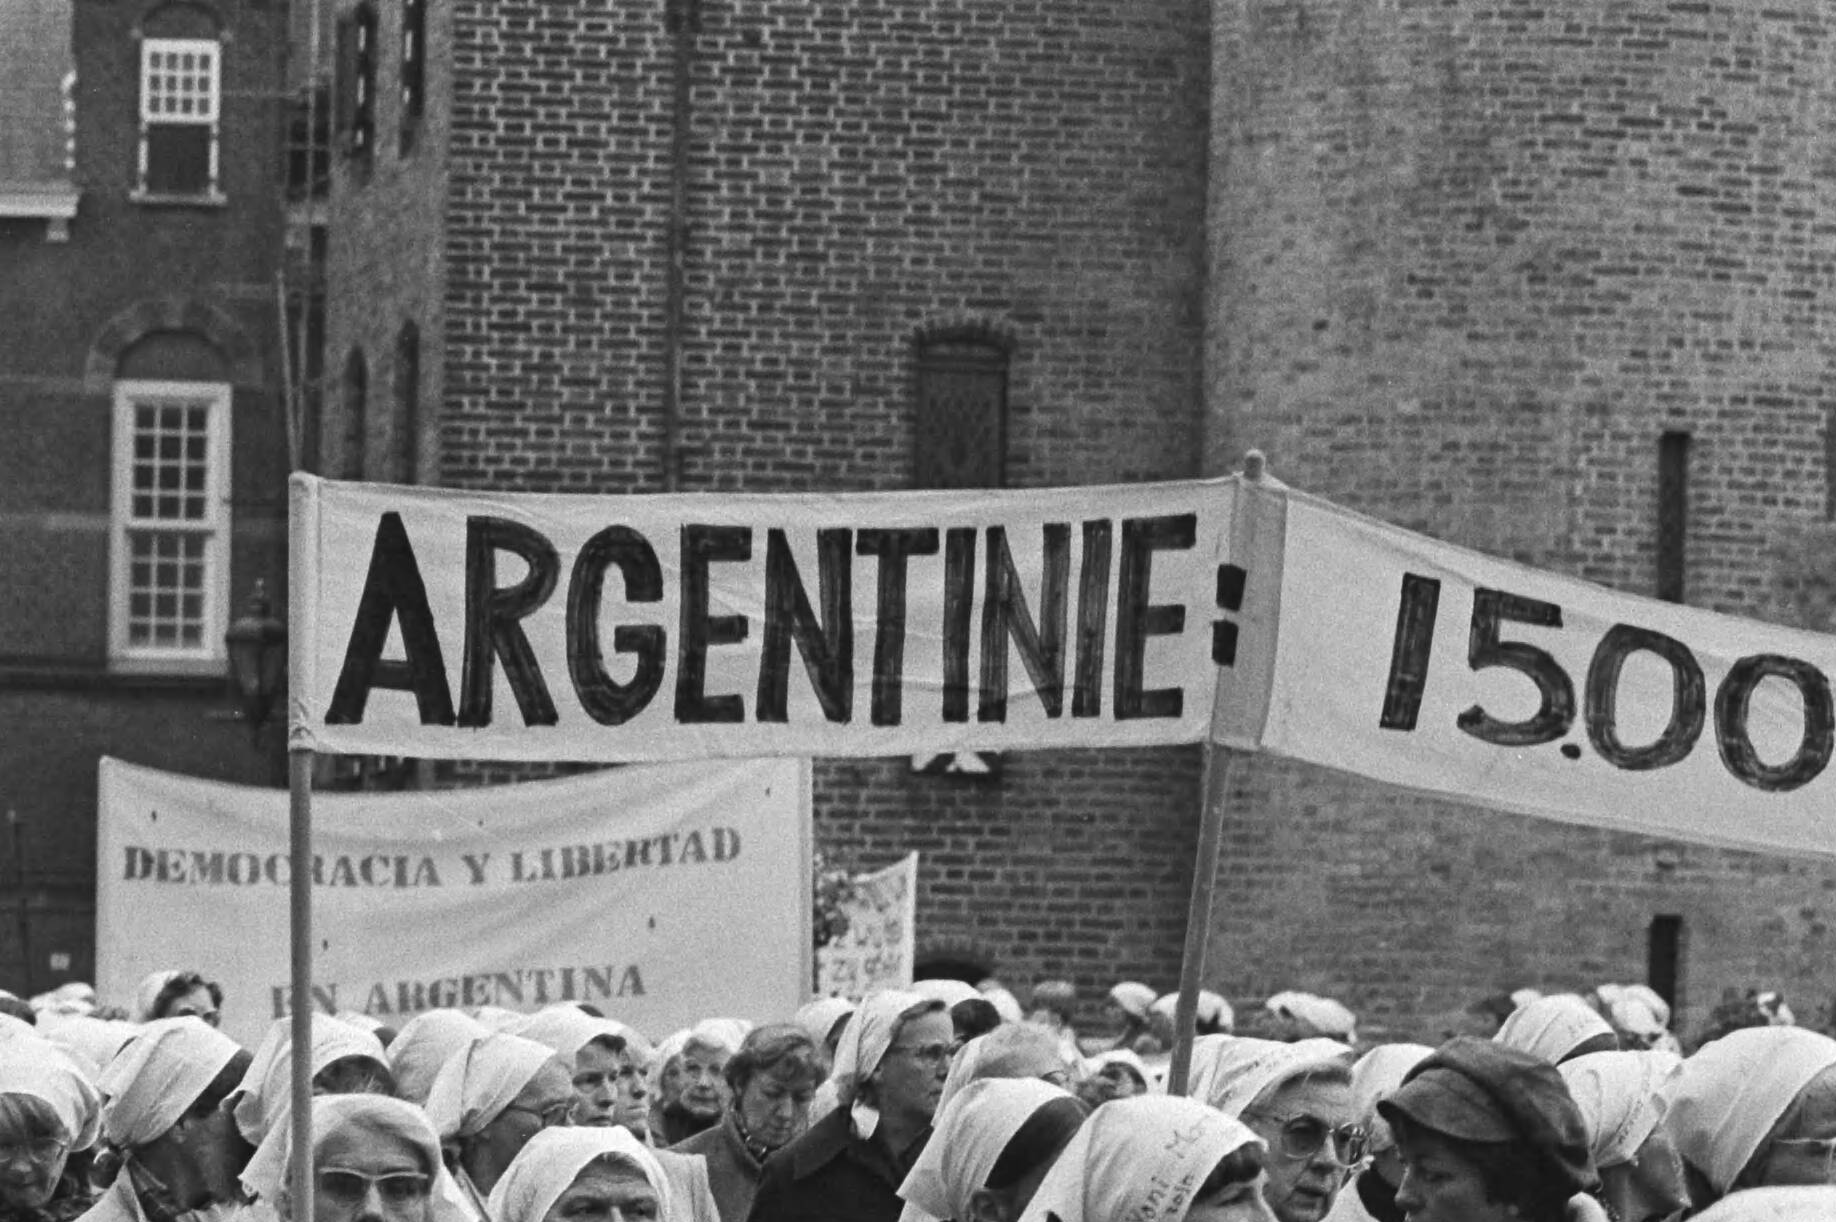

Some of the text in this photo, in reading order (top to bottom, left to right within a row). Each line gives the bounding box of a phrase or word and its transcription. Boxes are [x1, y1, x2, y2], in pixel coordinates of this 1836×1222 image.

[461, 852, 490, 885] Y
[511, 826, 741, 882] LIBERTAD
[364, 964, 646, 1016] ARGENTINA
